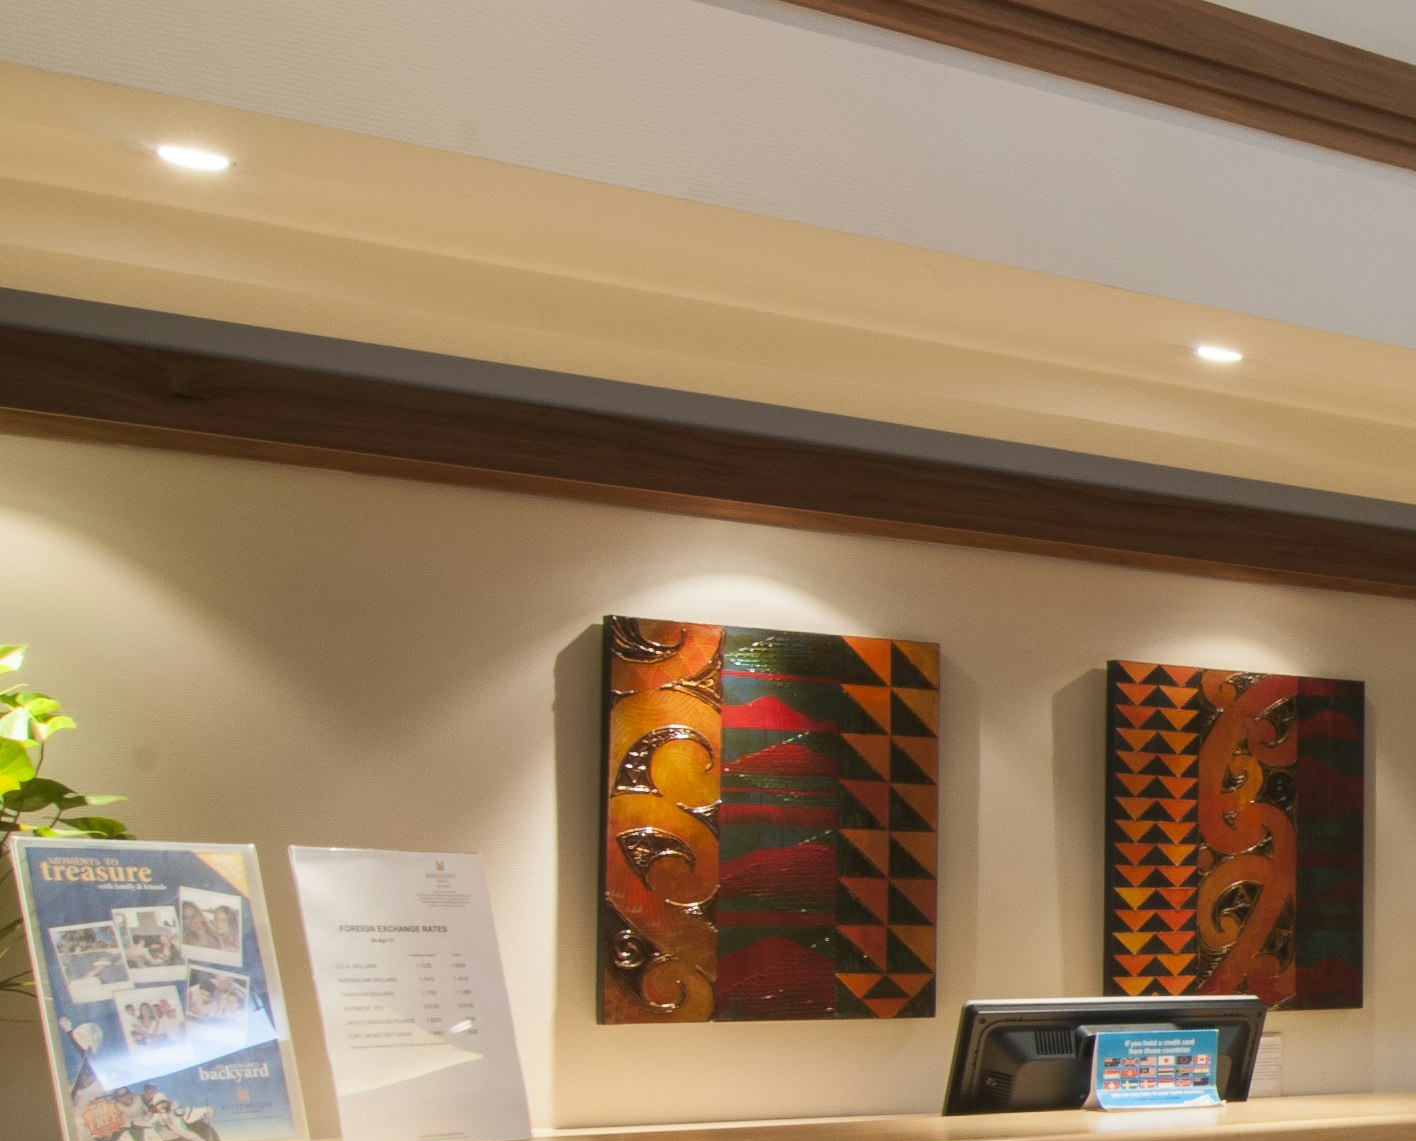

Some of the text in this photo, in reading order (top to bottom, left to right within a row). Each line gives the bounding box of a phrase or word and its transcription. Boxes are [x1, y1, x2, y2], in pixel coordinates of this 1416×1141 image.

[39, 861, 152, 882] treasure
[338, 925, 448, 933] FOREIGN EXCHANGE RATES
[198, 1063, 270, 1083] backyard
